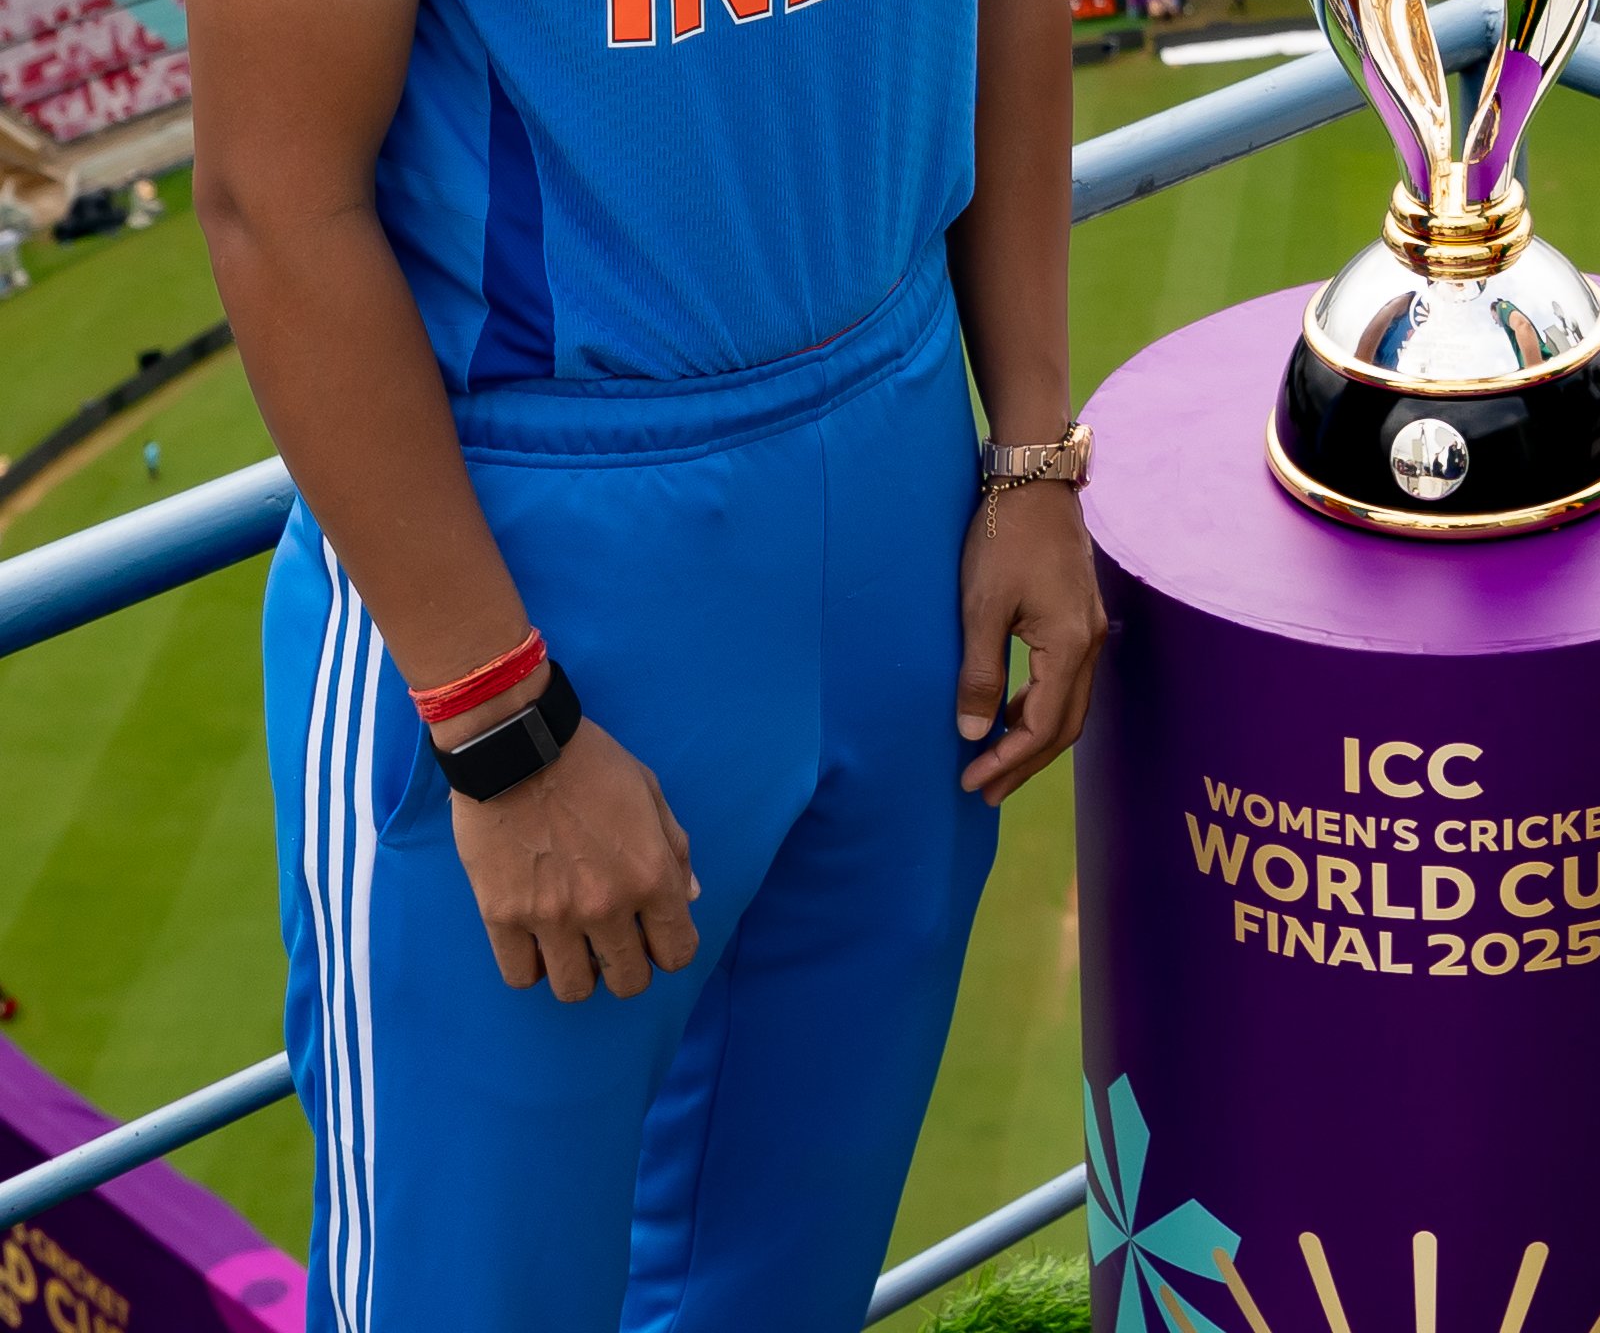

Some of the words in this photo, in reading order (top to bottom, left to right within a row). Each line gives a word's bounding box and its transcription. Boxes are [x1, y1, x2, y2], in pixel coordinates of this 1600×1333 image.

[1342, 736, 1485, 800] ICC
[1203, 775, 1421, 852] WOMEN'S
[1184, 811, 1476, 921] WORLD
[1233, 900, 1414, 975] FINAL
